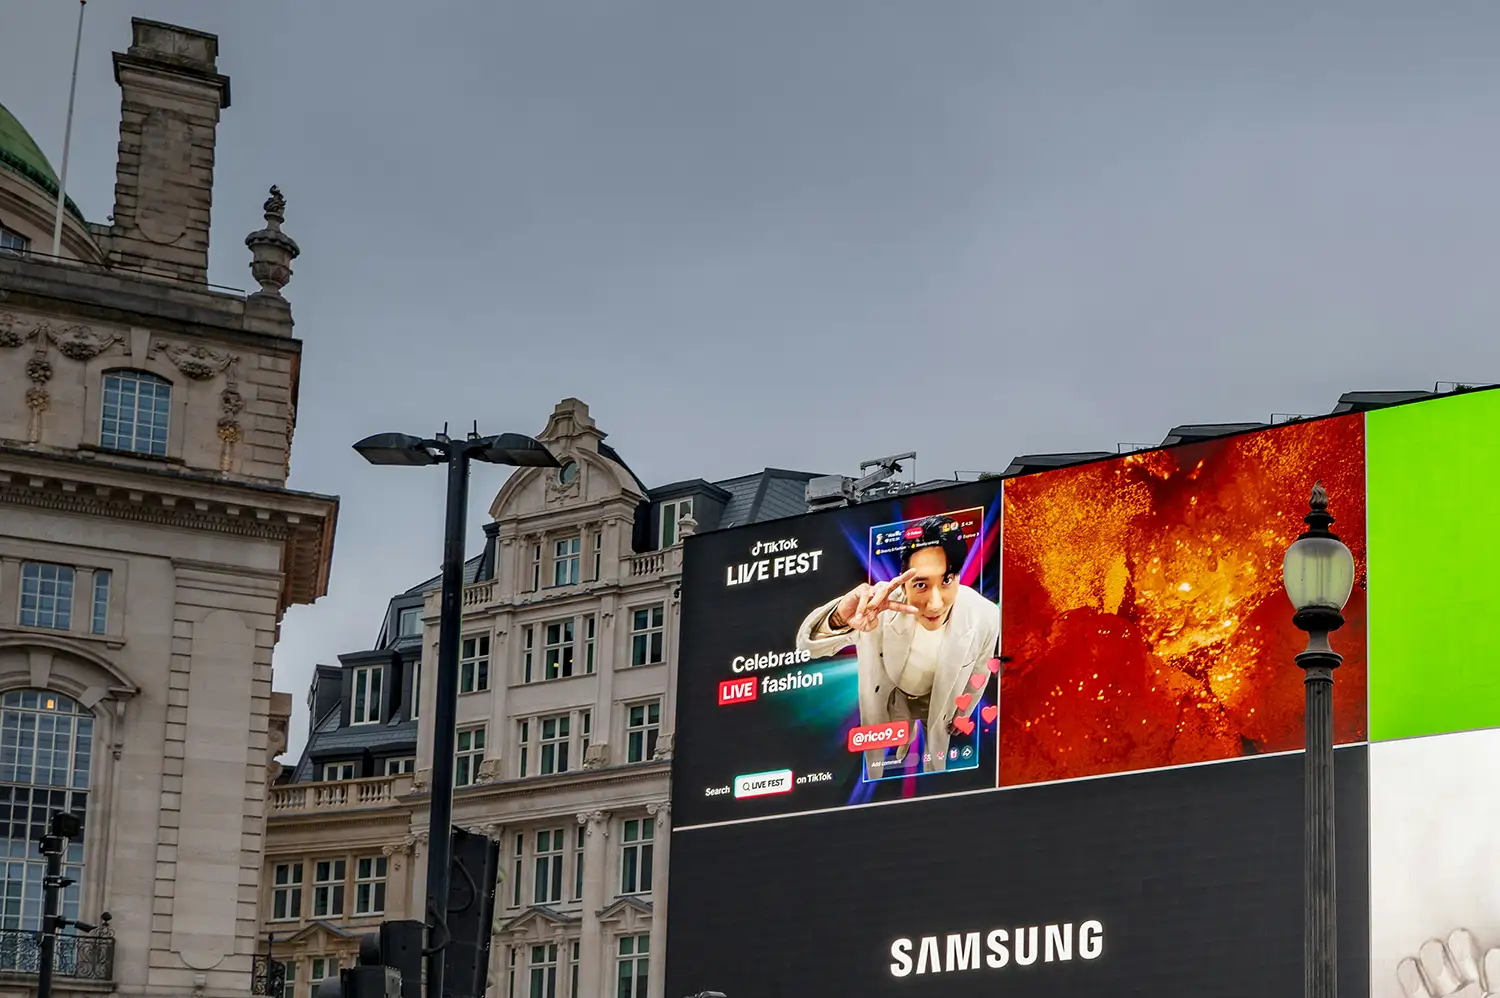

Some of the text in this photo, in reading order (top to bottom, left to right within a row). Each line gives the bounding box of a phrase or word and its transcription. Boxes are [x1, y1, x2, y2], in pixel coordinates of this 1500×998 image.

[763, 538, 798, 554] TikTok
[726, 549, 823, 587] LIVE FEST
[732, 648, 811, 673] Celebrate
[722, 670, 823, 701] LIVE fashion
[852, 727, 905, 745] @rico9_c
[705, 771, 832, 797] Search LIVE FEST on TikTok
[889, 919, 1104, 978] SAMSUNG
